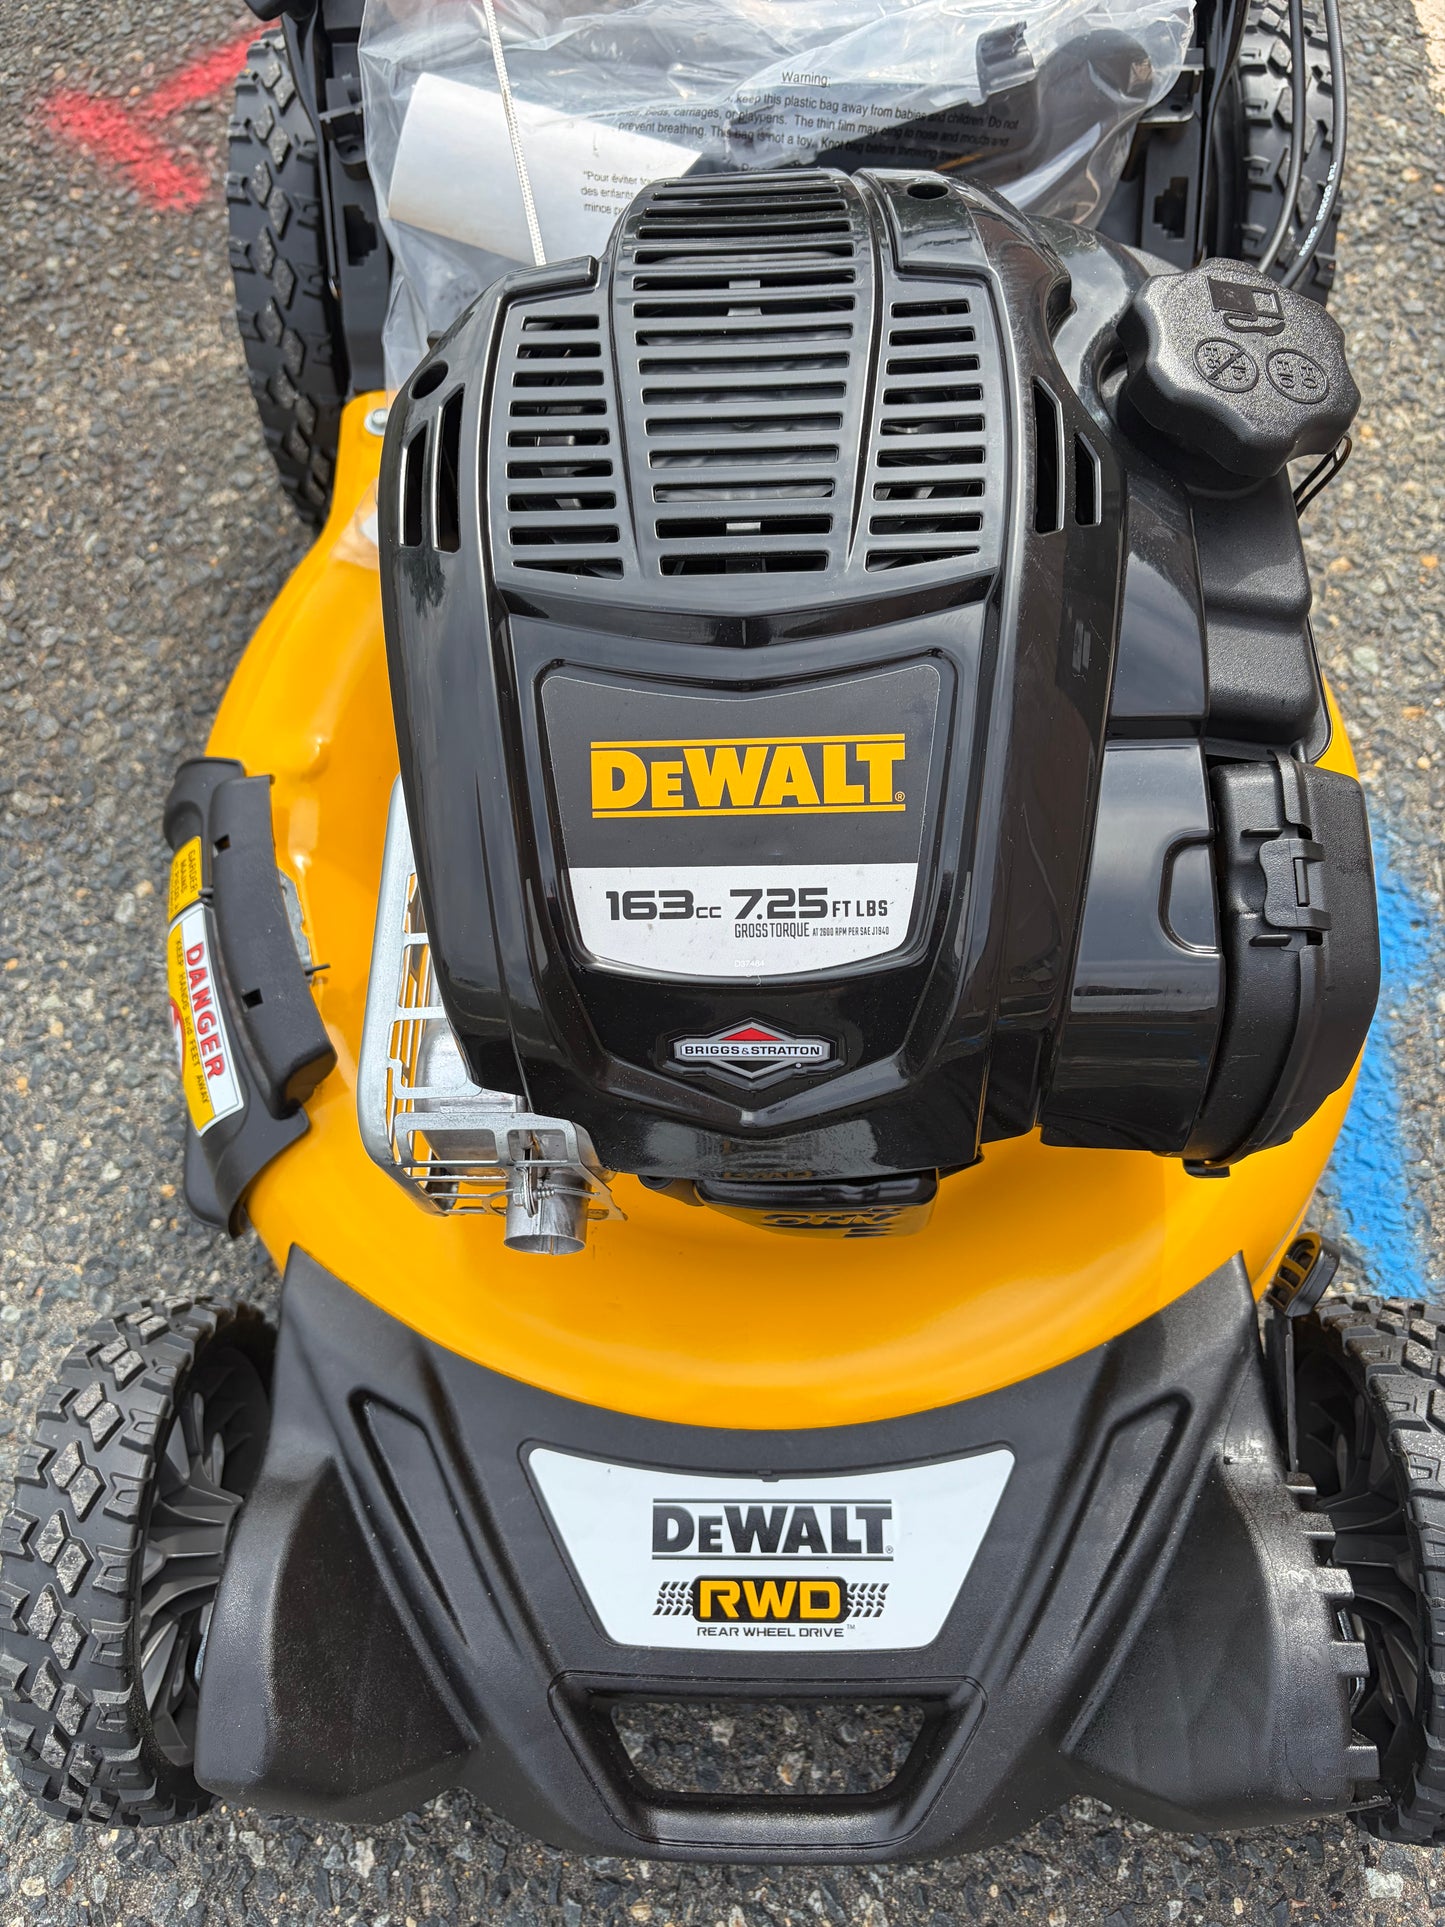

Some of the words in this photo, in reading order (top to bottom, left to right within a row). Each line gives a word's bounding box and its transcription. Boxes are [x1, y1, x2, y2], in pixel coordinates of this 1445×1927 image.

[781, 71, 831, 88] Warning:
[674, 108, 722, 121] carriages,
[725, 110, 737, 119] or
[739, 111, 787, 125] playpens.
[795, 114, 813, 127] The
[817, 117, 836, 130] thin
[839, 119, 855, 133] film
[858, 123, 880, 138] may
[764, 93, 782, 105] this
[785, 95, 816, 110] plastic
[820, 99, 839, 114] bag
[841, 103, 868, 117] away
[871, 104, 893, 118] from
[988, 116, 1001, 128] Do
[1003, 119, 1019, 129] not
[618, 121, 655, 133] prevent
[657, 123, 706, 139] breathing.
[730, 887, 828, 919] 7.25
[832, 900, 851, 917] FT
[857, 900, 888, 916] LBS
[734, 923, 768, 938] GROSS
[769, 922, 810, 939] TORQUE
[848, 927, 859, 935] PER
[860, 927, 871, 935] SAE
[176, 938, 184, 967] KEEP
[179, 972, 190, 1010] HANDS
[186, 941, 225, 1080] DANGER
[189, 1039, 200, 1067] FEET
[196, 1074, 209, 1103] AWAY
[700, 1581, 841, 1619] RWD
[697, 1626, 739, 1637] REAR
[743, 1627, 796, 1637] WHEEL
[799, 1627, 844, 1637] DRIVE
